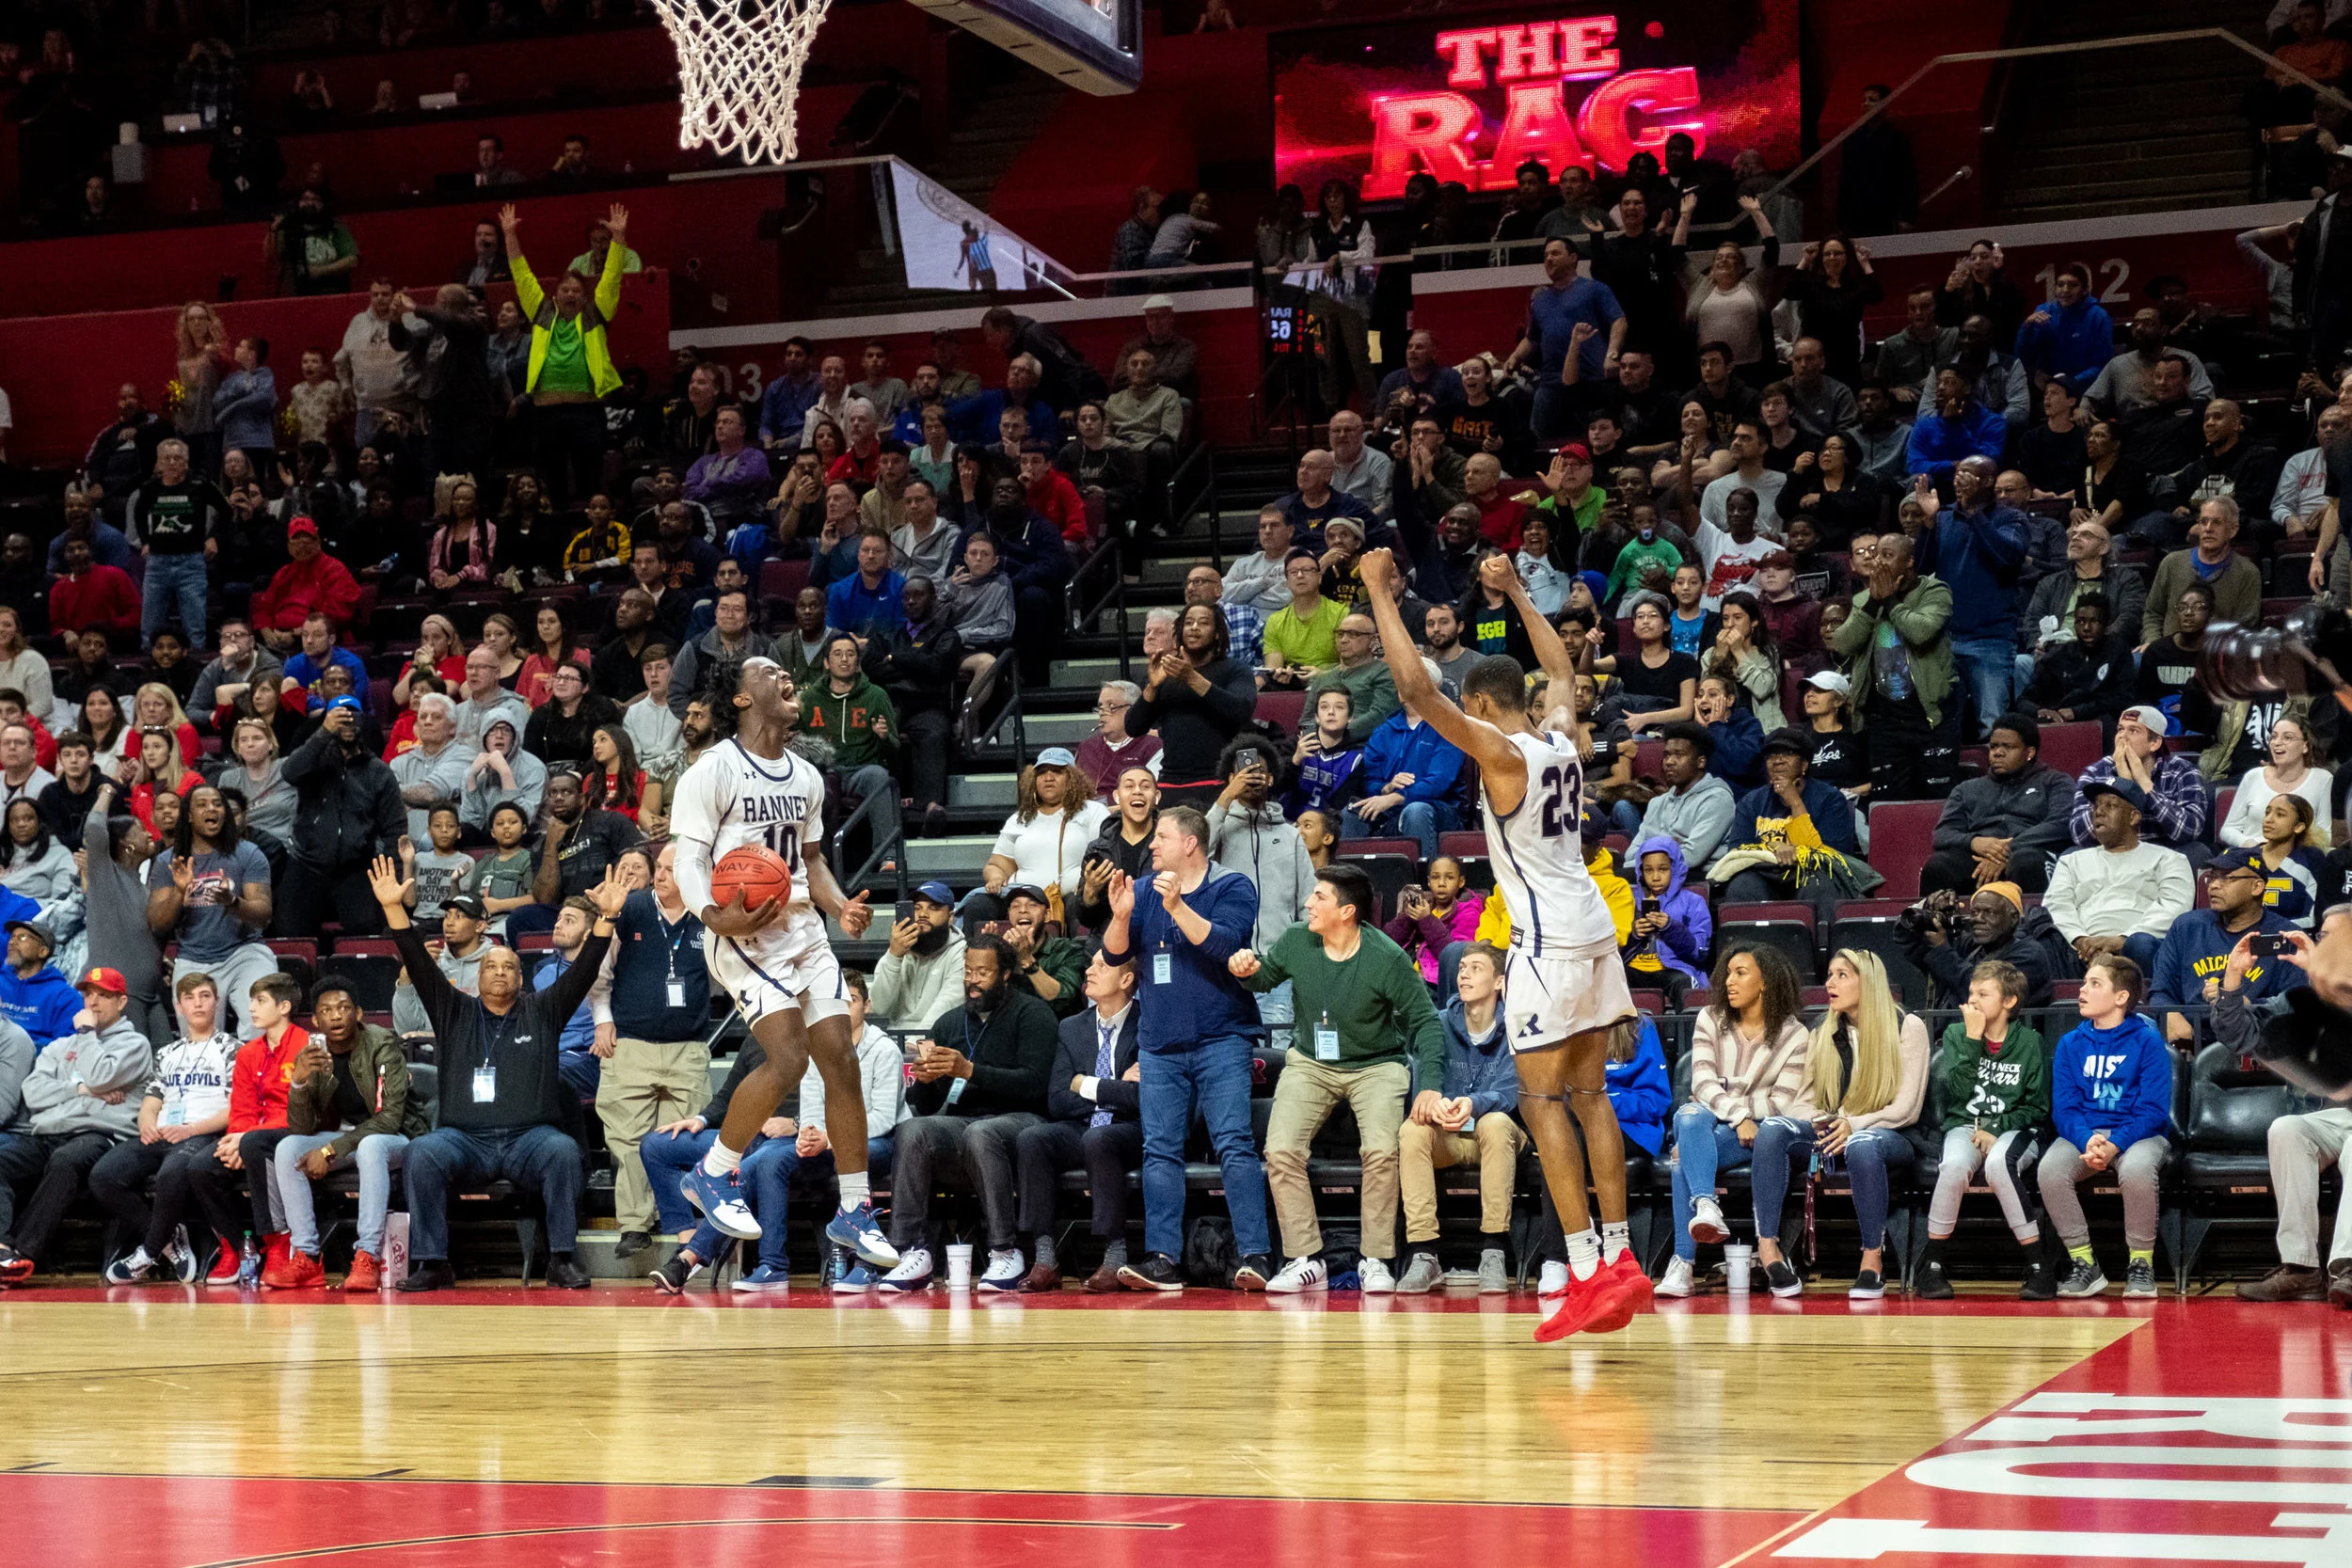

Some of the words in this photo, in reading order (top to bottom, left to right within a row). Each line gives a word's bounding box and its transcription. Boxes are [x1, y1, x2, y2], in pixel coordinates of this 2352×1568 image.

[1436, 15, 1620, 89] THE
[809, 705, 825, 727] A
[850, 707, 866, 728] E
[1541, 762, 1581, 837] 23
[763, 824, 799, 876] 10
[715, 862, 765, 875] WAVE
[426, 876, 442, 886] DAY
[1996, 1062, 2022, 1073] NECK
[184, 1072, 220, 1086] DEVILS
